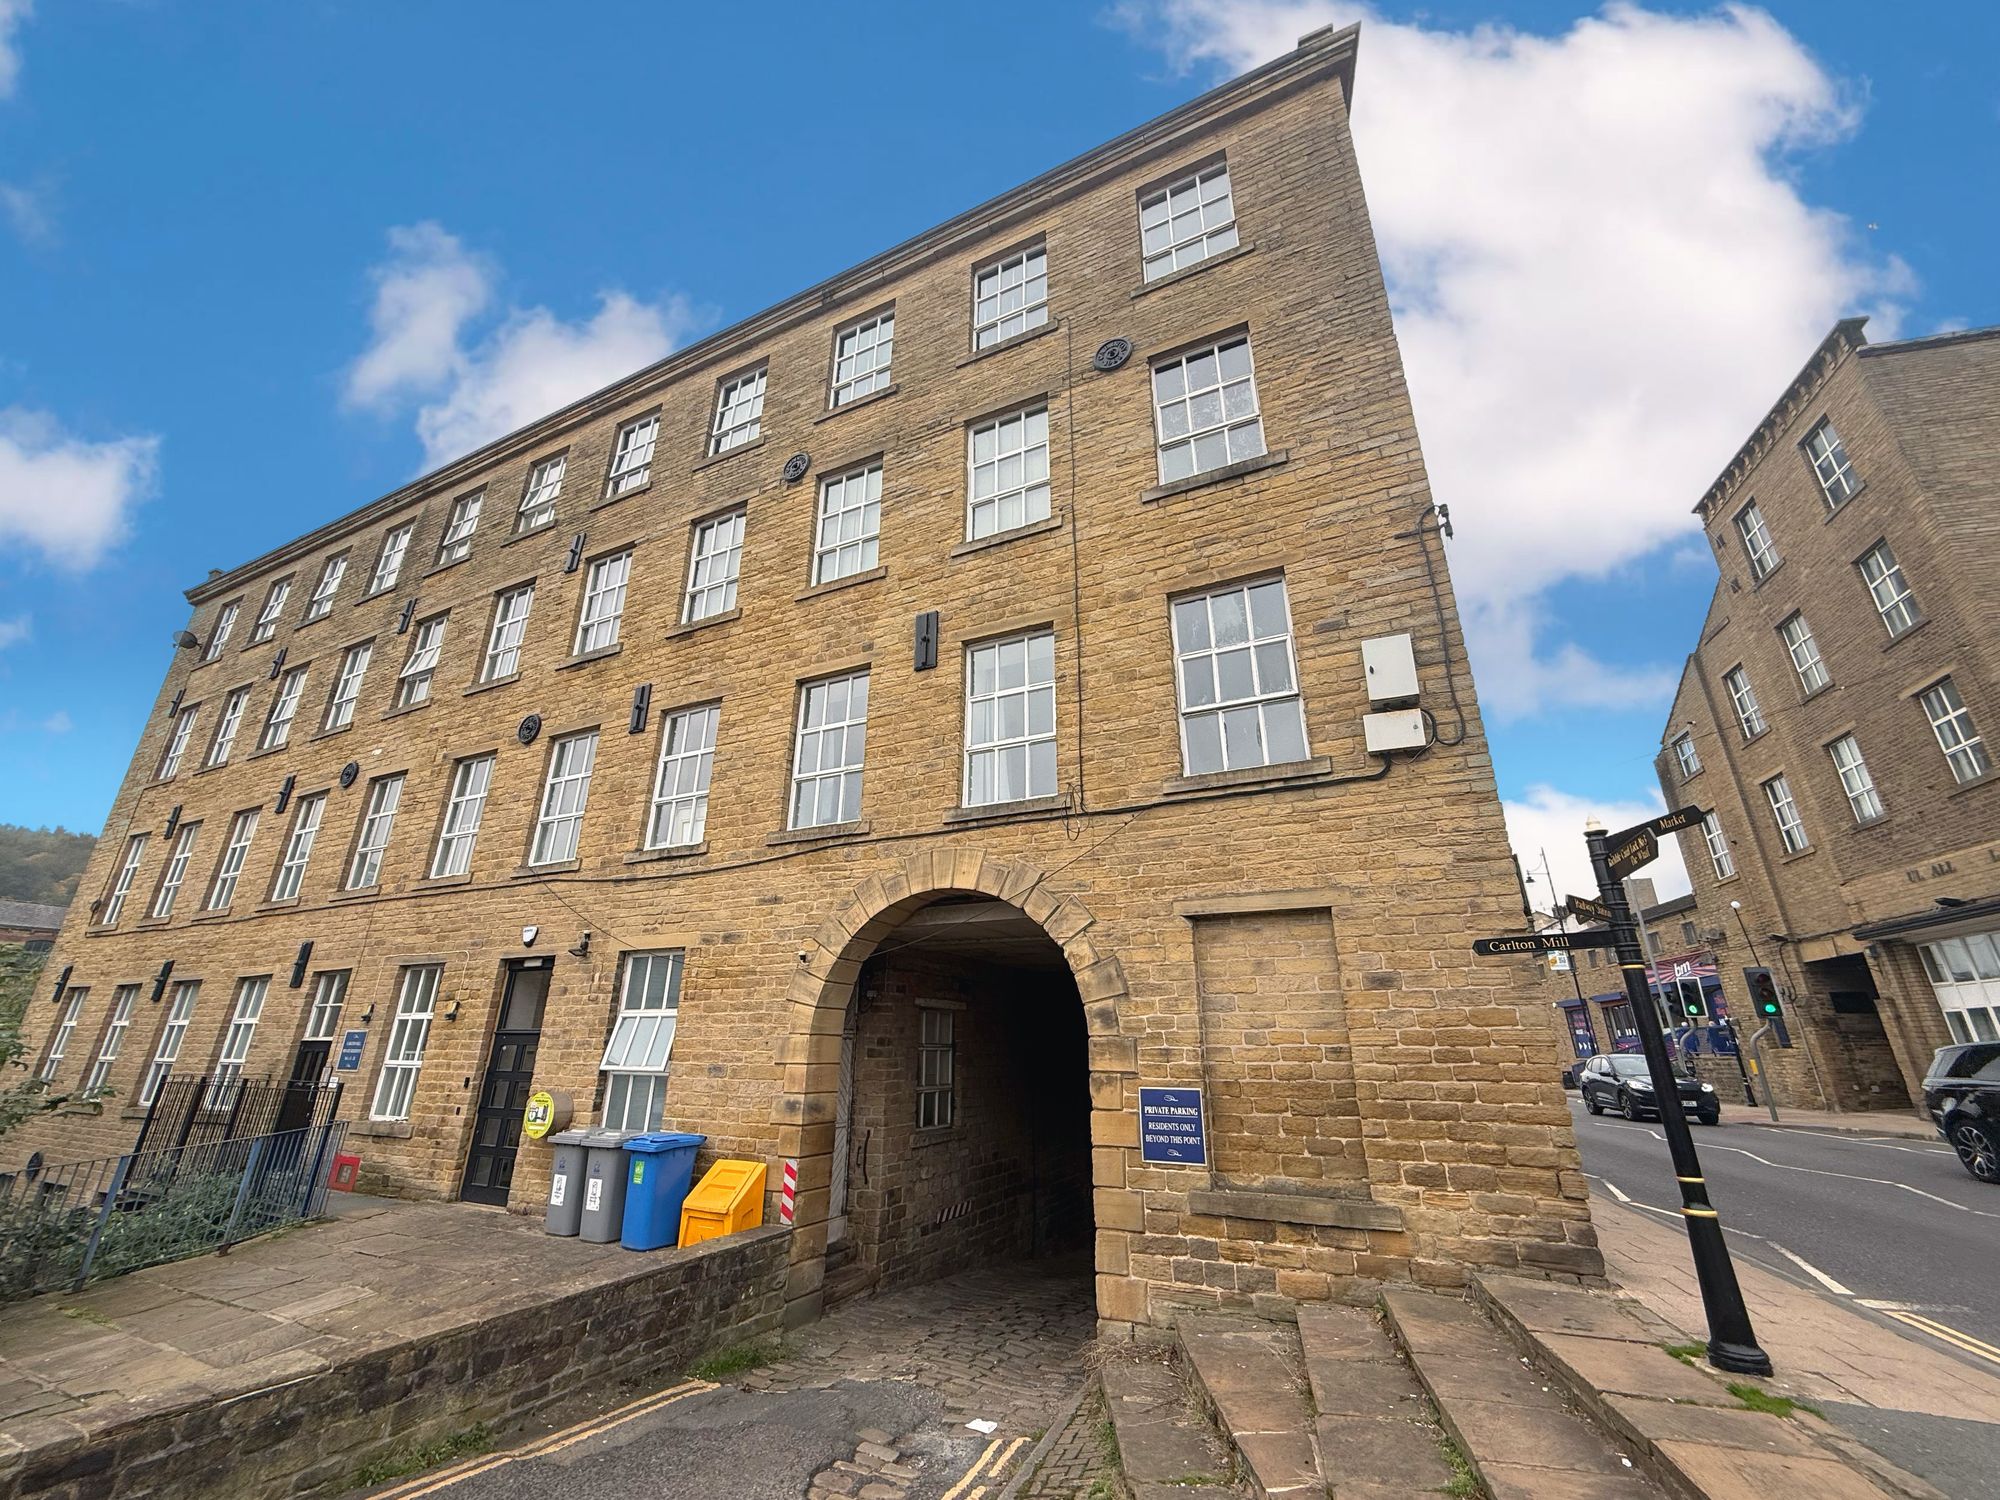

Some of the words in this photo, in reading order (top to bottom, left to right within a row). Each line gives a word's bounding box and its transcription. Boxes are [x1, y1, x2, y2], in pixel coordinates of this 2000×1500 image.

[1660, 814, 1686, 830] Market
[1489, 940, 1536, 952] Carlton
[1541, 936, 1570, 948] Mill
[1144, 1106, 1170, 1114] PRIVATE
[1170, 1107, 1198, 1116] PARKING
[1148, 1122, 1180, 1131] RESIDENTS
[1180, 1124, 1196, 1132] ONLY
[1145, 1134, 1170, 1143] BEYOND
[1170, 1136, 1182, 1144] THIS
[1183, 1137, 1200, 1145] POINT
